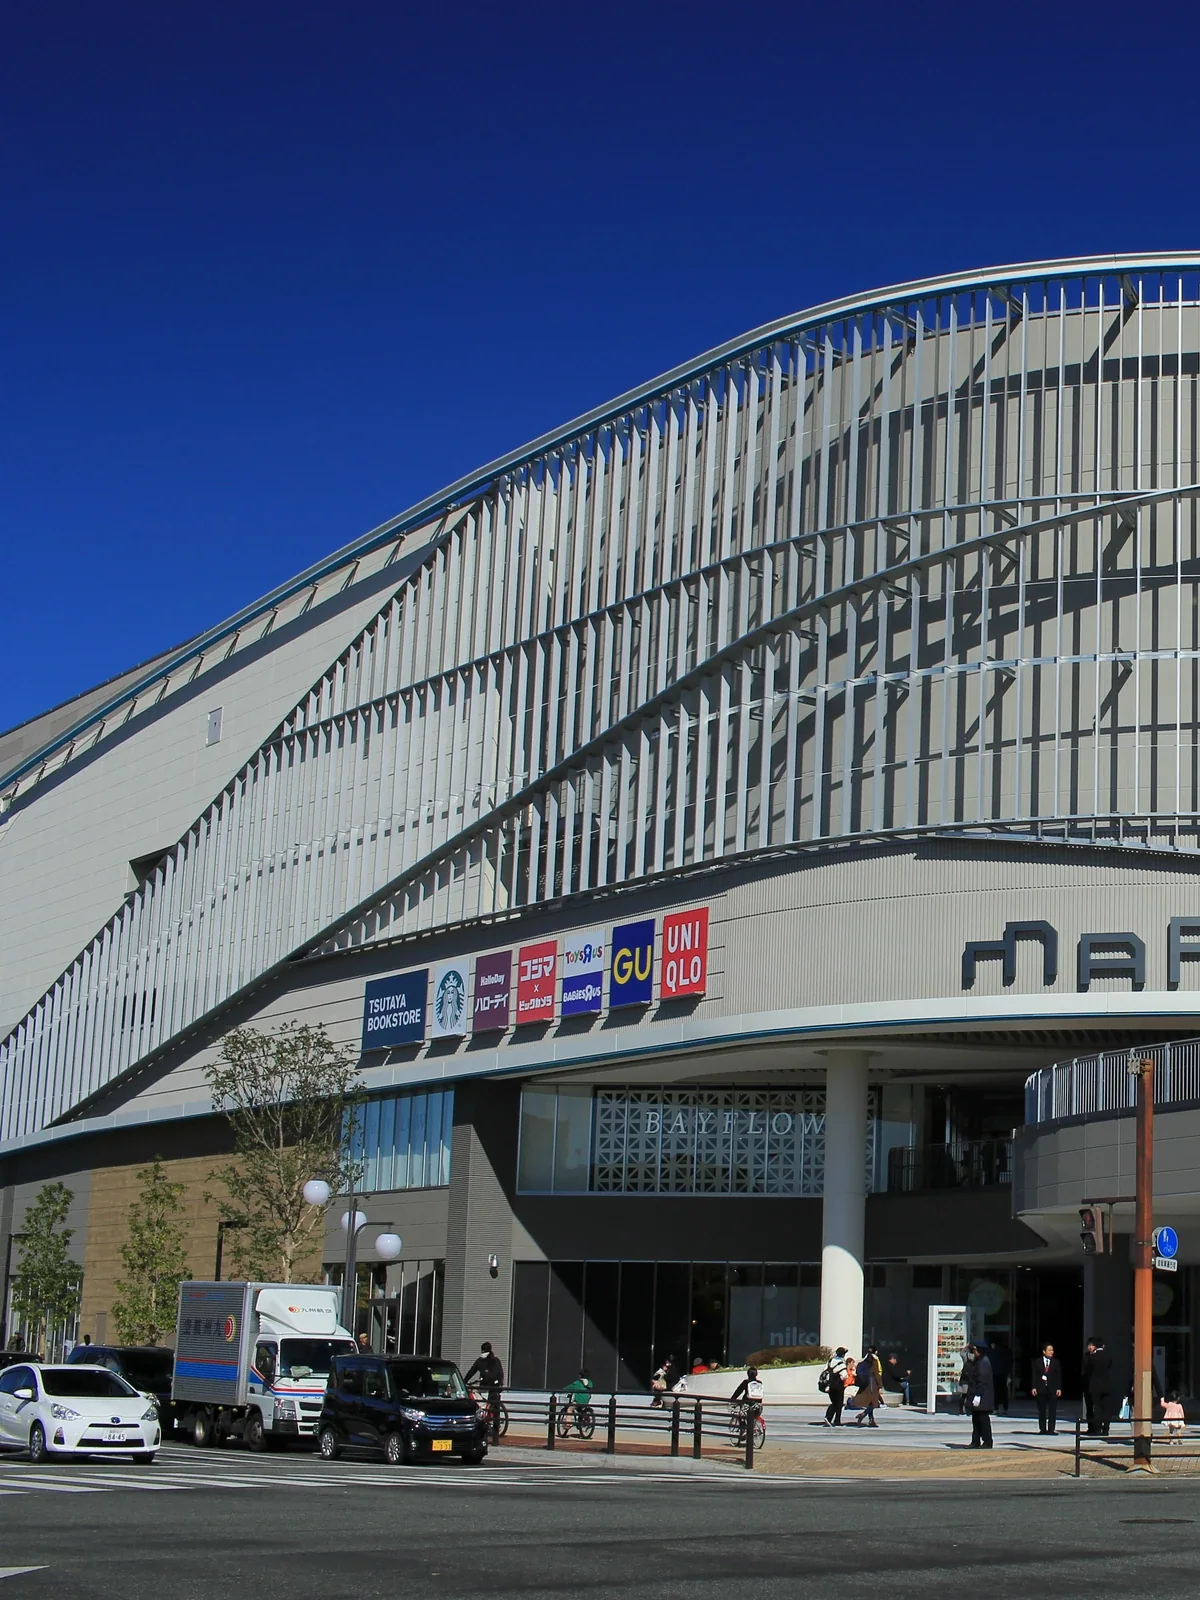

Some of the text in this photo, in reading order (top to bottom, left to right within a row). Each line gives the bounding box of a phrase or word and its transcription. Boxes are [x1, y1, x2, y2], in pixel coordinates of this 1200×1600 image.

[668, 921, 700, 953] UNI
[520, 954, 554, 982] コジマ
[613, 945, 652, 985] GU
[666, 956, 702, 993] QLO
[480, 973, 505, 987] HalloDay
[369, 993, 407, 1014] TSUTAYA
[518, 995, 552, 1012] ビックカメラ
[367, 1008, 421, 1032] BOOKSTORE
[645, 1112, 826, 1135] BAYFLOW
